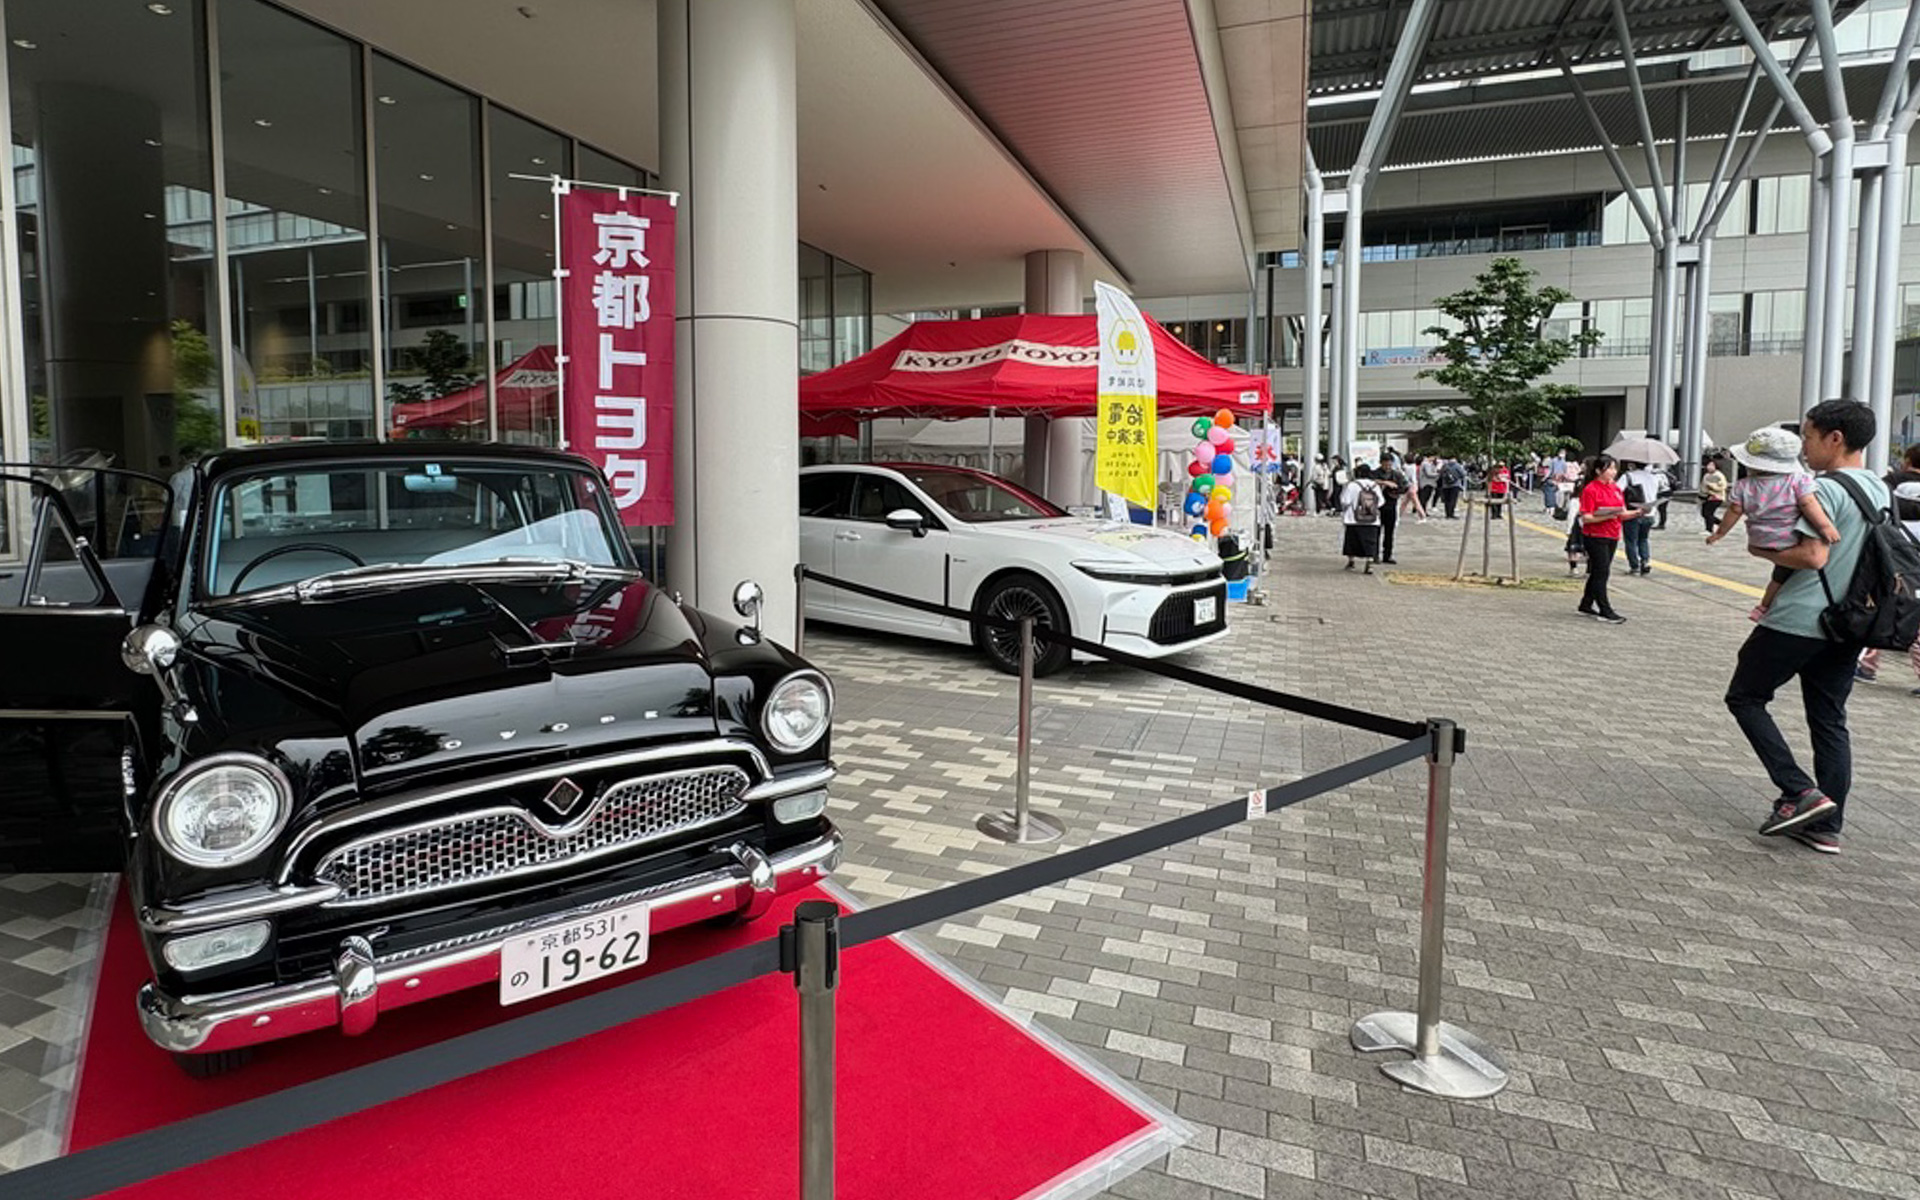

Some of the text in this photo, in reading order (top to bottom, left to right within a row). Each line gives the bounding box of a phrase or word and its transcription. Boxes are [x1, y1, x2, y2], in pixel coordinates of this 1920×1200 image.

[591, 211, 651, 510] 京都トヨタ
[904, 348, 1001, 367] KYOTO
[511, 931, 641, 989] の 19-62
